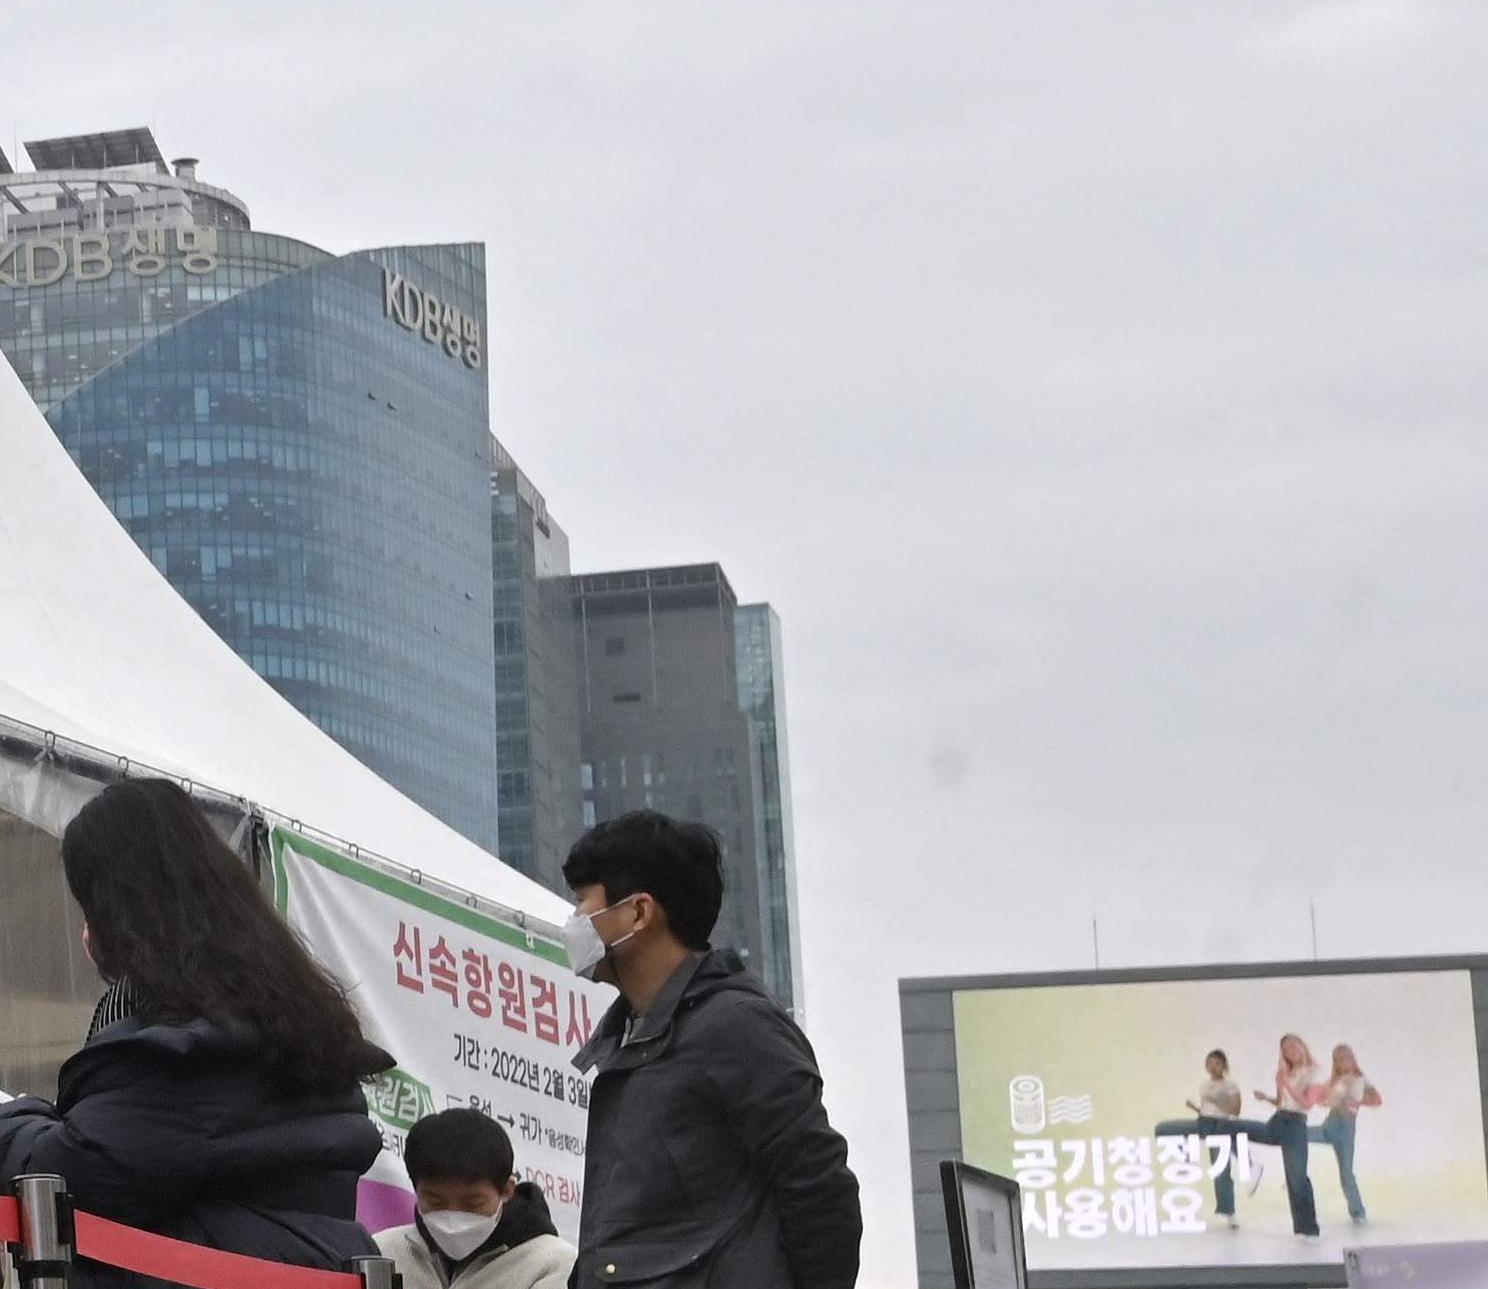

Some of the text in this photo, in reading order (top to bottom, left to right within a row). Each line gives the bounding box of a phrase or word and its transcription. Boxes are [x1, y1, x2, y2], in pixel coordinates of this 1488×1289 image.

[383, 268, 481, 368] KDB생명
[393, 920, 592, 1047] 신속항원검사
[453, 1033, 480, 1071] 기간
[490, 1046, 540, 1093] 2022년
[543, 1066, 565, 1101] 2월
[568, 1075, 591, 1109] 3일
[1012, 1132, 1251, 1189] 공기청정기
[1022, 1187, 1207, 1239] 사용해요
